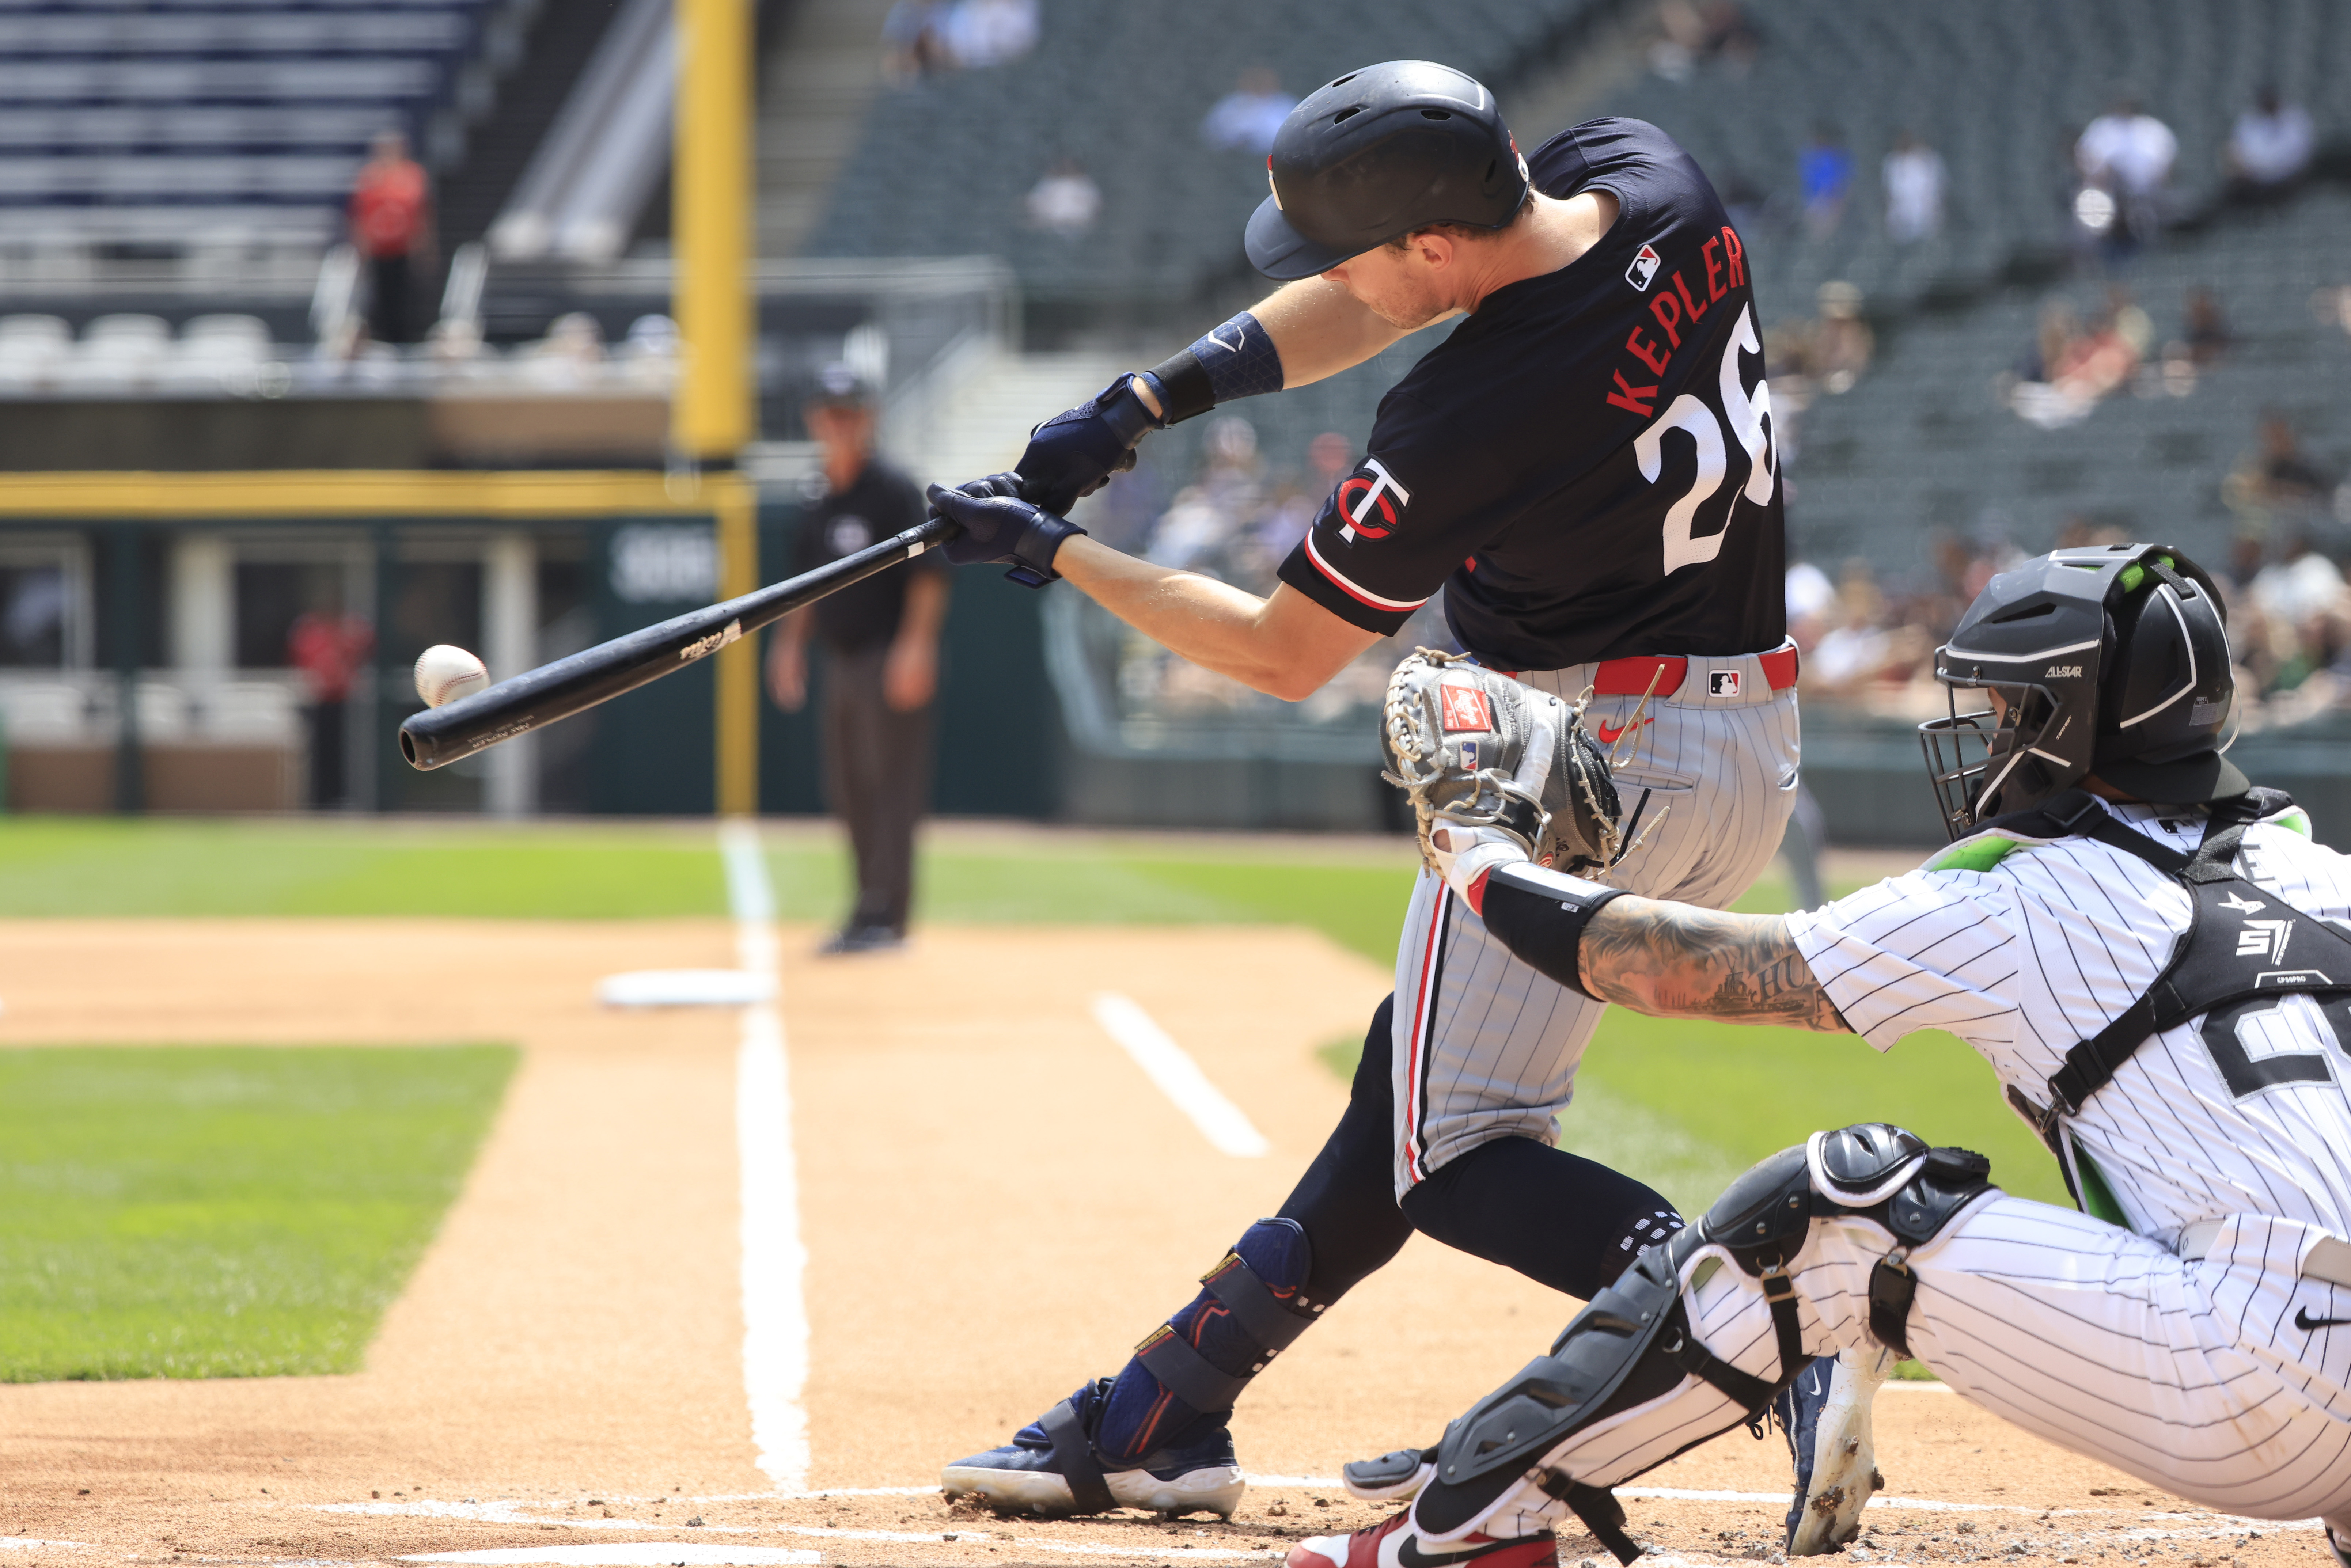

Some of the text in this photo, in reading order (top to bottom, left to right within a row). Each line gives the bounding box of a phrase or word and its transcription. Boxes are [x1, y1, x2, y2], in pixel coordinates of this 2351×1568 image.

[1606, 226, 1744, 418] KEPLER
[1633, 301, 1777, 576] 26
[1456, 689, 1479, 725] Rawlings
